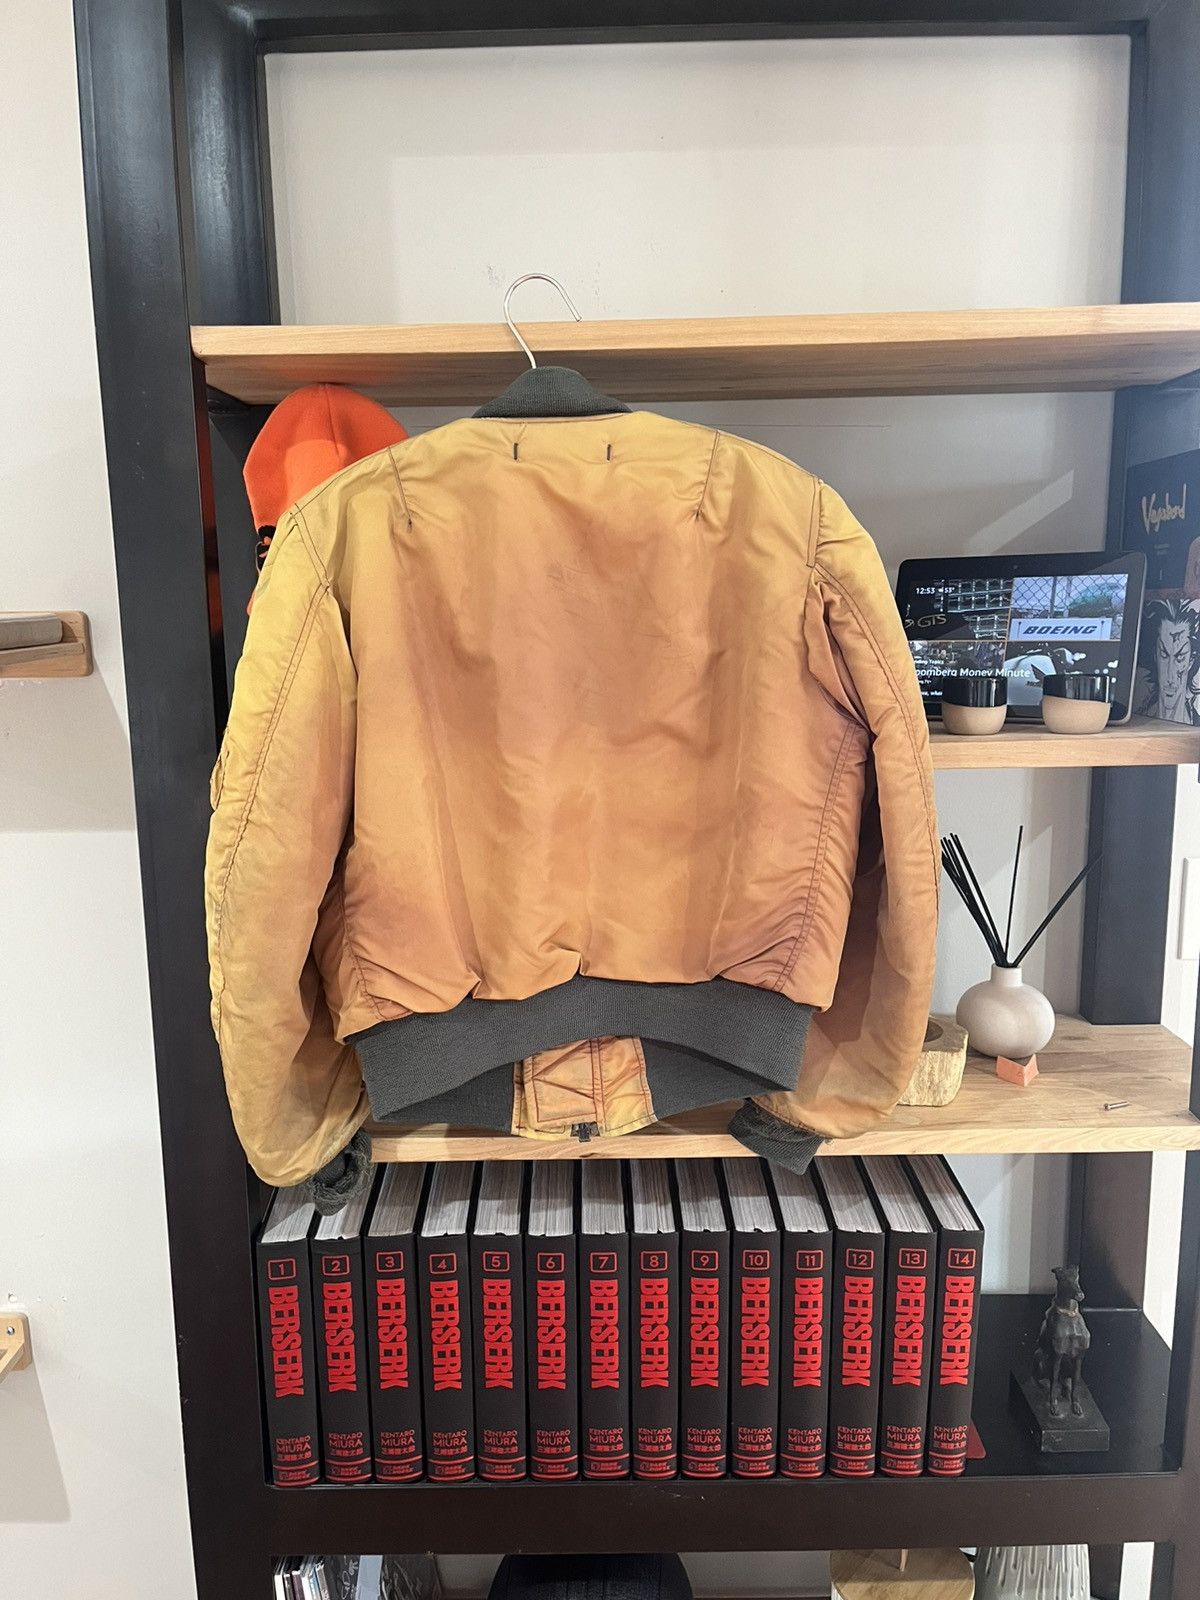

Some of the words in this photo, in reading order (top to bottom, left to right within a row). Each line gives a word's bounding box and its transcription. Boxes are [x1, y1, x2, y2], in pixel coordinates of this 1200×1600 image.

[917, 613, 947, 627] GTS
[1023, 625, 1098, 635] BOEING
[995, 668, 1030, 677] Minute
[385, 1256, 395, 1268] 3
[437, 1259, 447, 1270] 4
[491, 1256, 501, 1268] 5
[545, 1257, 556, 1268] 6
[598, 1257, 609, 1268] 7
[649, 1255, 659, 1267] 8
[700, 1255, 710, 1267] 9
[749, 1255, 764, 1266] 10
[804, 1255, 816, 1267] 11
[852, 1253, 868, 1266] 12
[905, 1253, 921, 1265] 13
[954, 1253, 970, 1265] 14
[278, 1264, 284, 1275] 1
[331, 1260, 341, 1272] 2
[377, 1278, 409, 1390] BERSERK
[430, 1279, 462, 1391] BERSERK
[483, 1278, 513, 1389] BERSERK
[537, 1279, 566, 1390] BERSERK
[589, 1279, 619, 1389] BERSERK
[640, 1277, 669, 1388] BERSERK
[690, 1277, 720, 1387] BERSERK
[741, 1276, 770, 1387] BERSERK
[793, 1276, 824, 1387] BERSERK
[842, 1275, 874, 1387] BERSERK
[892, 1275, 926, 1386] BERSERK
[939, 1275, 975, 1385] BERSERK
[269, 1285, 304, 1398] BERSERK
[323, 1281, 357, 1393] BERSERK
[887, 1425, 921, 1433] KENTARO
[381, 1437, 415, 1447] MIURA
[433, 1437, 467, 1447] MIURA
[484, 1437, 517, 1445] MIURA
[537, 1436, 570, 1445] MIURA
[589, 1434, 623, 1444] MIURA
[639, 1434, 672, 1443] MIURA
[688, 1434, 721, 1444] MIURA
[738, 1434, 772, 1443] MIURA
[788, 1434, 821, 1444] MIURA
[838, 1432, 871, 1442] MIURA
[887, 1432, 921, 1441] MIURA
[934, 1432, 967, 1442] MIURA
[277, 1442, 311, 1453] MIURA
[329, 1439, 363, 1448] MIURA
